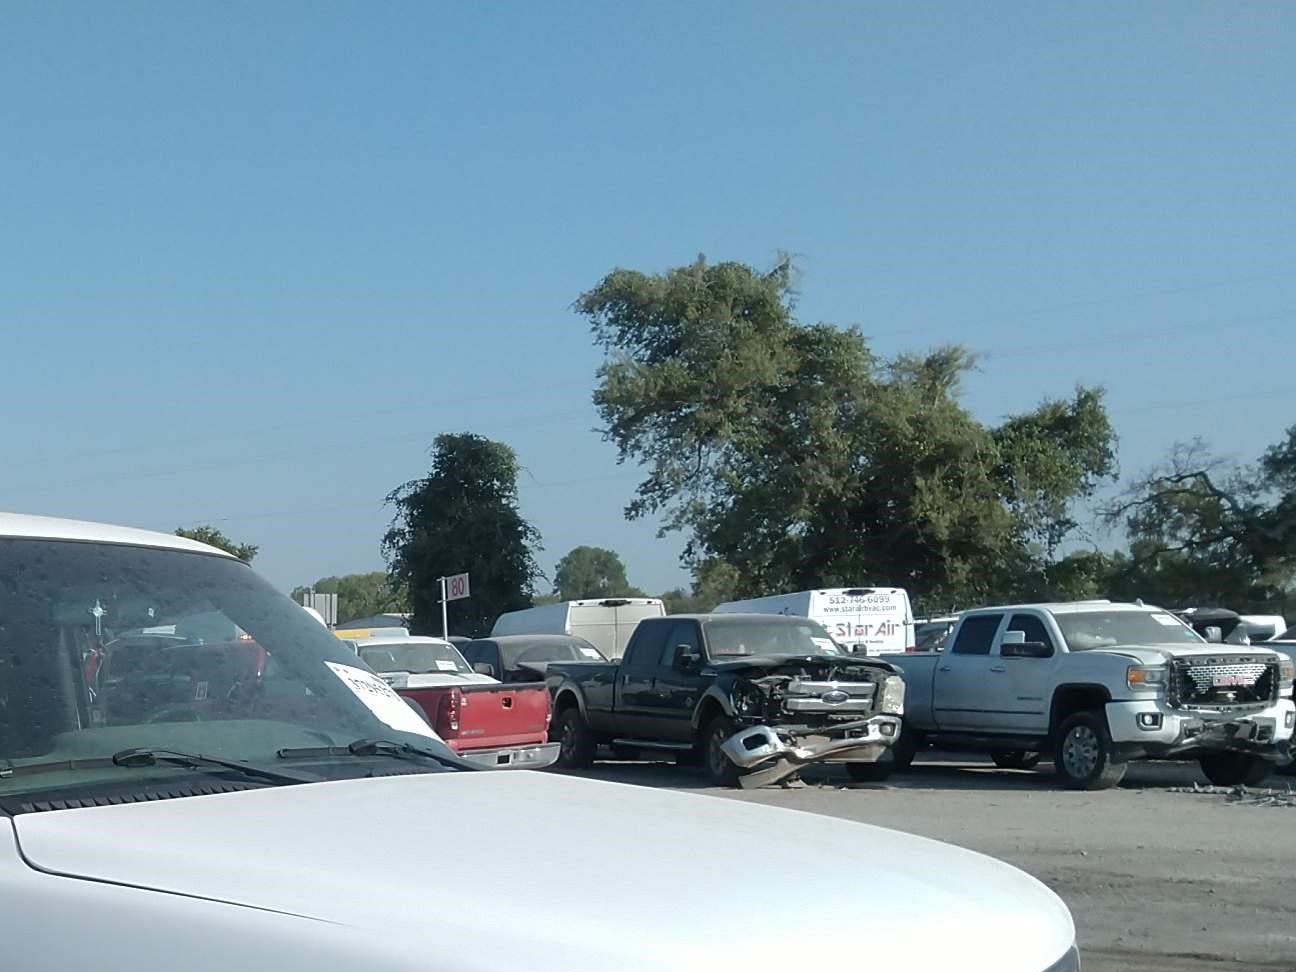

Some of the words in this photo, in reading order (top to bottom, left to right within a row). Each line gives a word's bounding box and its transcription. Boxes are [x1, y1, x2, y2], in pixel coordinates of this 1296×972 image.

[451, 577, 464, 597] 80
[836, 622, 873, 637] Star
[875, 620, 900, 637] Air
